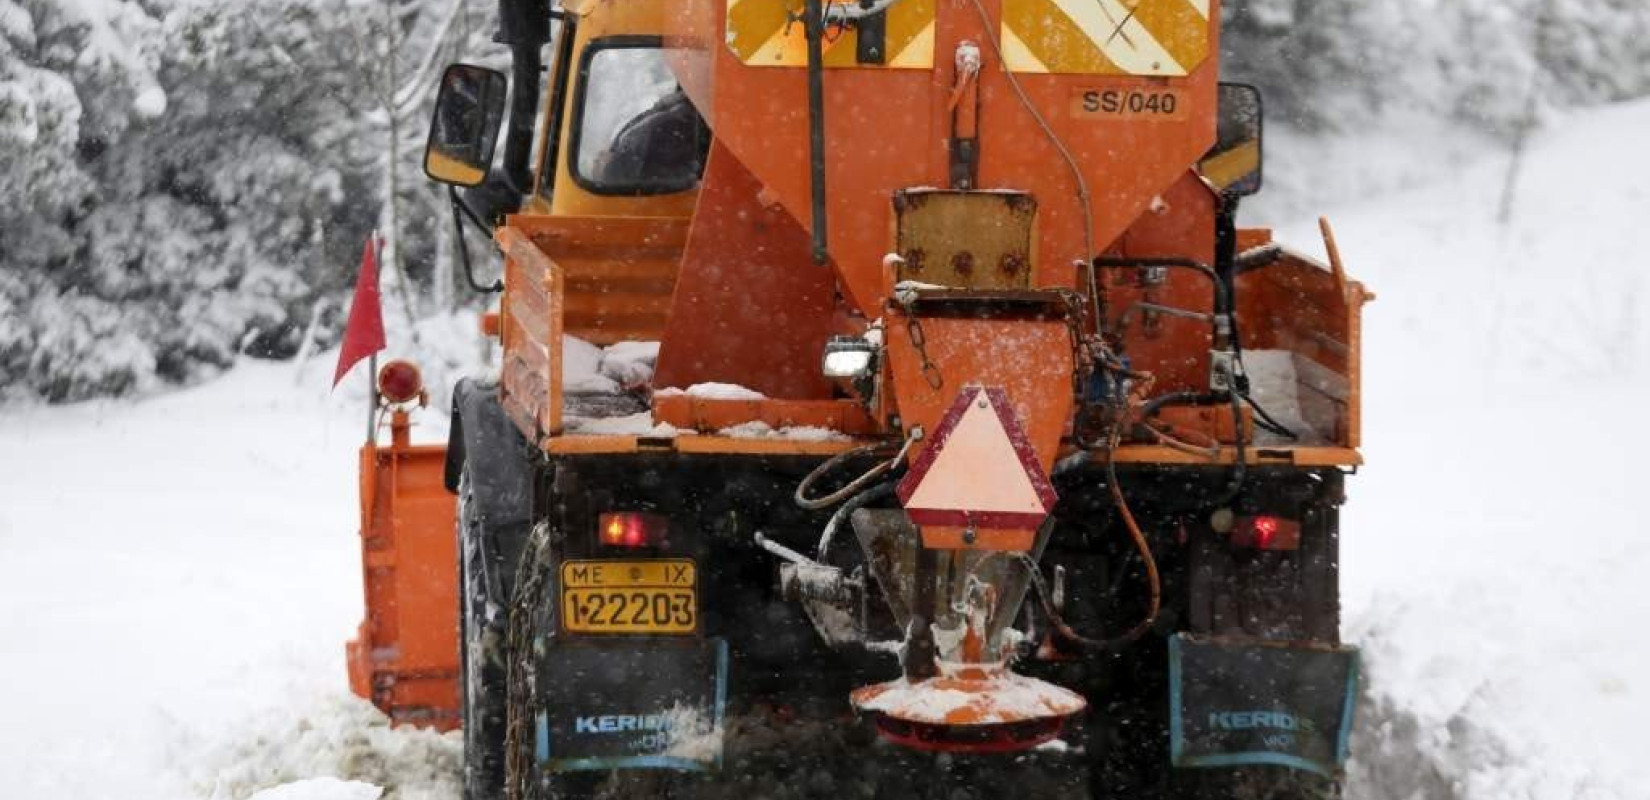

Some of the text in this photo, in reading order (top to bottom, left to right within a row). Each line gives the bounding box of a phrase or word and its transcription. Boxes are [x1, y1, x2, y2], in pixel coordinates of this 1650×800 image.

[1082, 90, 1176, 114] SS/040
[572, 565, 687, 584] ME IX
